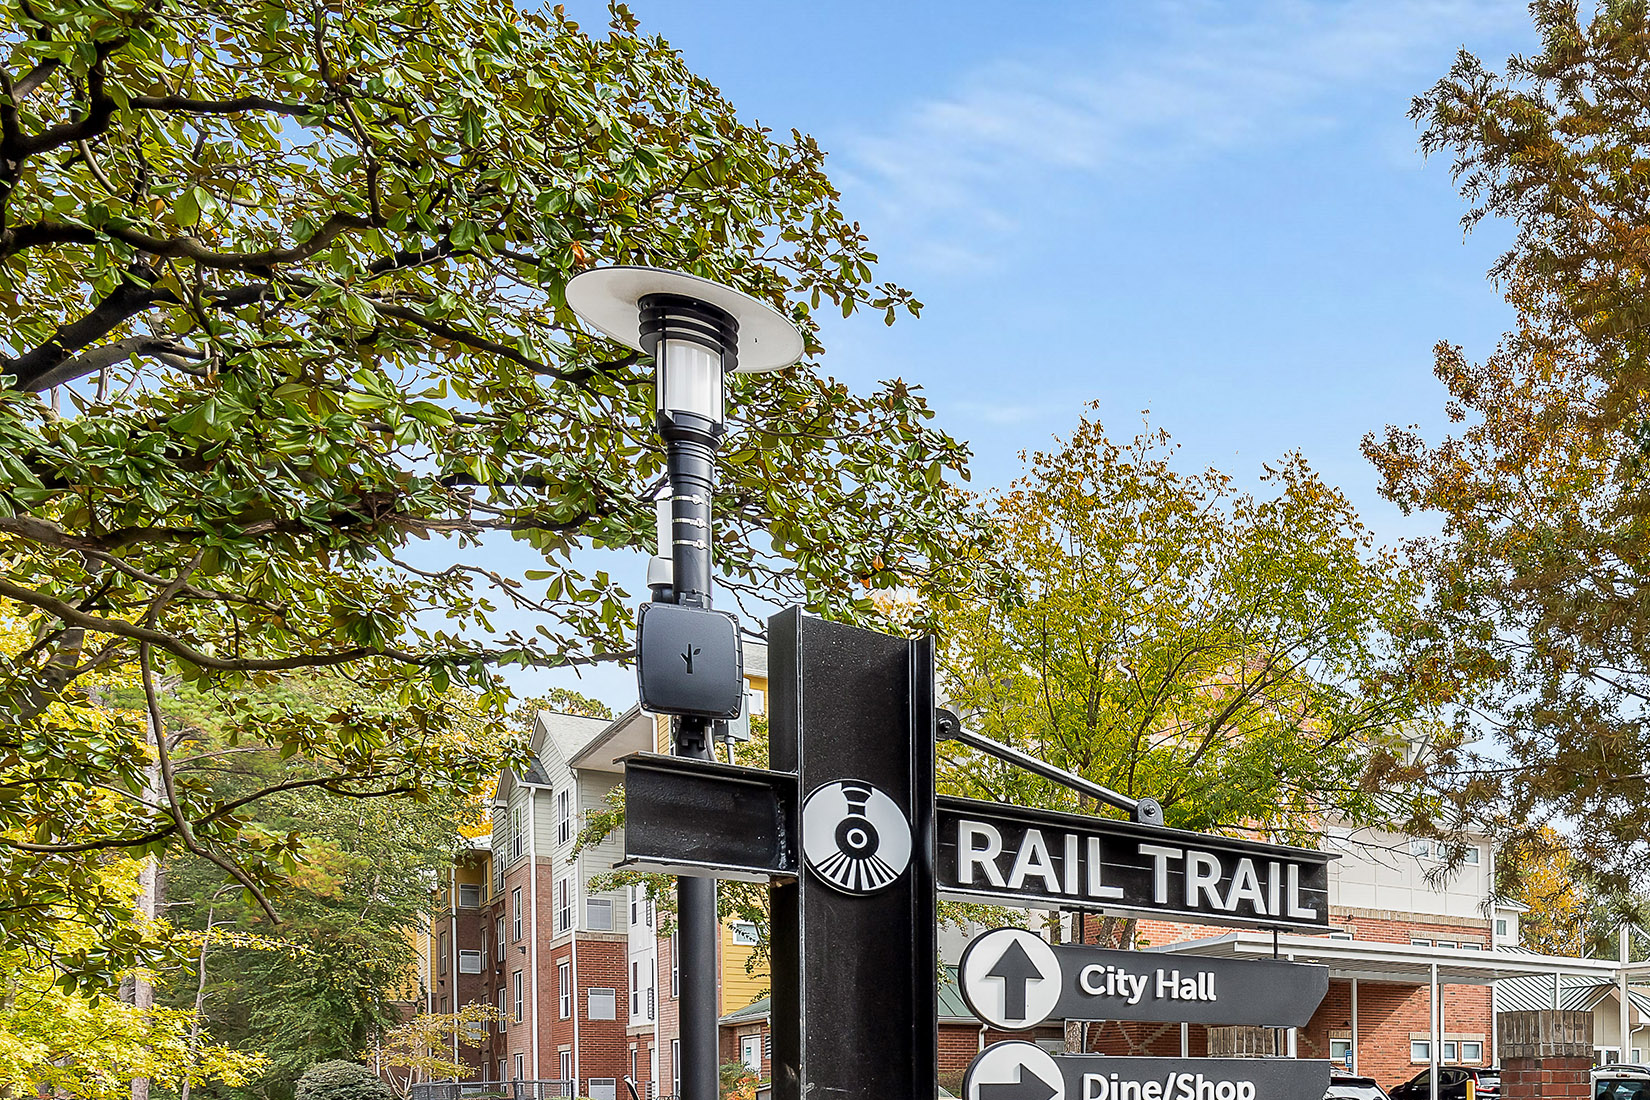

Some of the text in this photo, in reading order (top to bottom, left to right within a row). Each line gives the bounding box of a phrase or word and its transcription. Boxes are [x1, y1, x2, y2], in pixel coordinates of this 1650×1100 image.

[957, 819, 1318, 920] RAIL TRAIL
[1080, 964, 1217, 1004] City Hall
